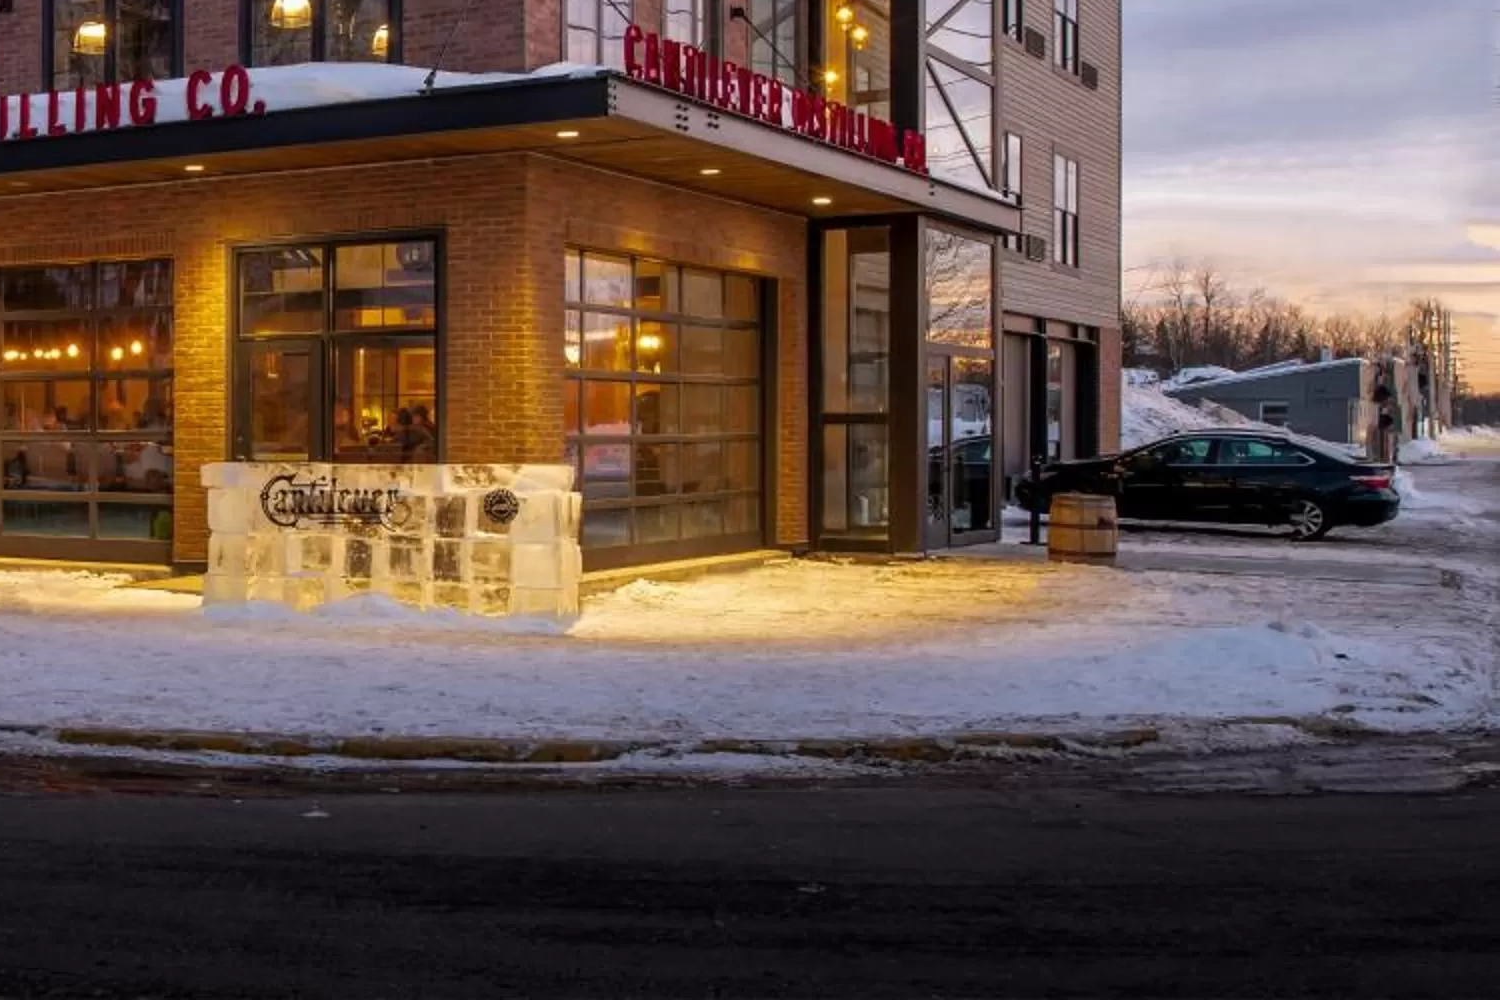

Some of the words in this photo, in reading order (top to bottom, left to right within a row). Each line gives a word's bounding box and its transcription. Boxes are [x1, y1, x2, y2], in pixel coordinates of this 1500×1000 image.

[186, 66, 267, 121] CO.
[625, 25, 783, 125] CANTILEVER
[260, 474, 409, 531] Cantilever
